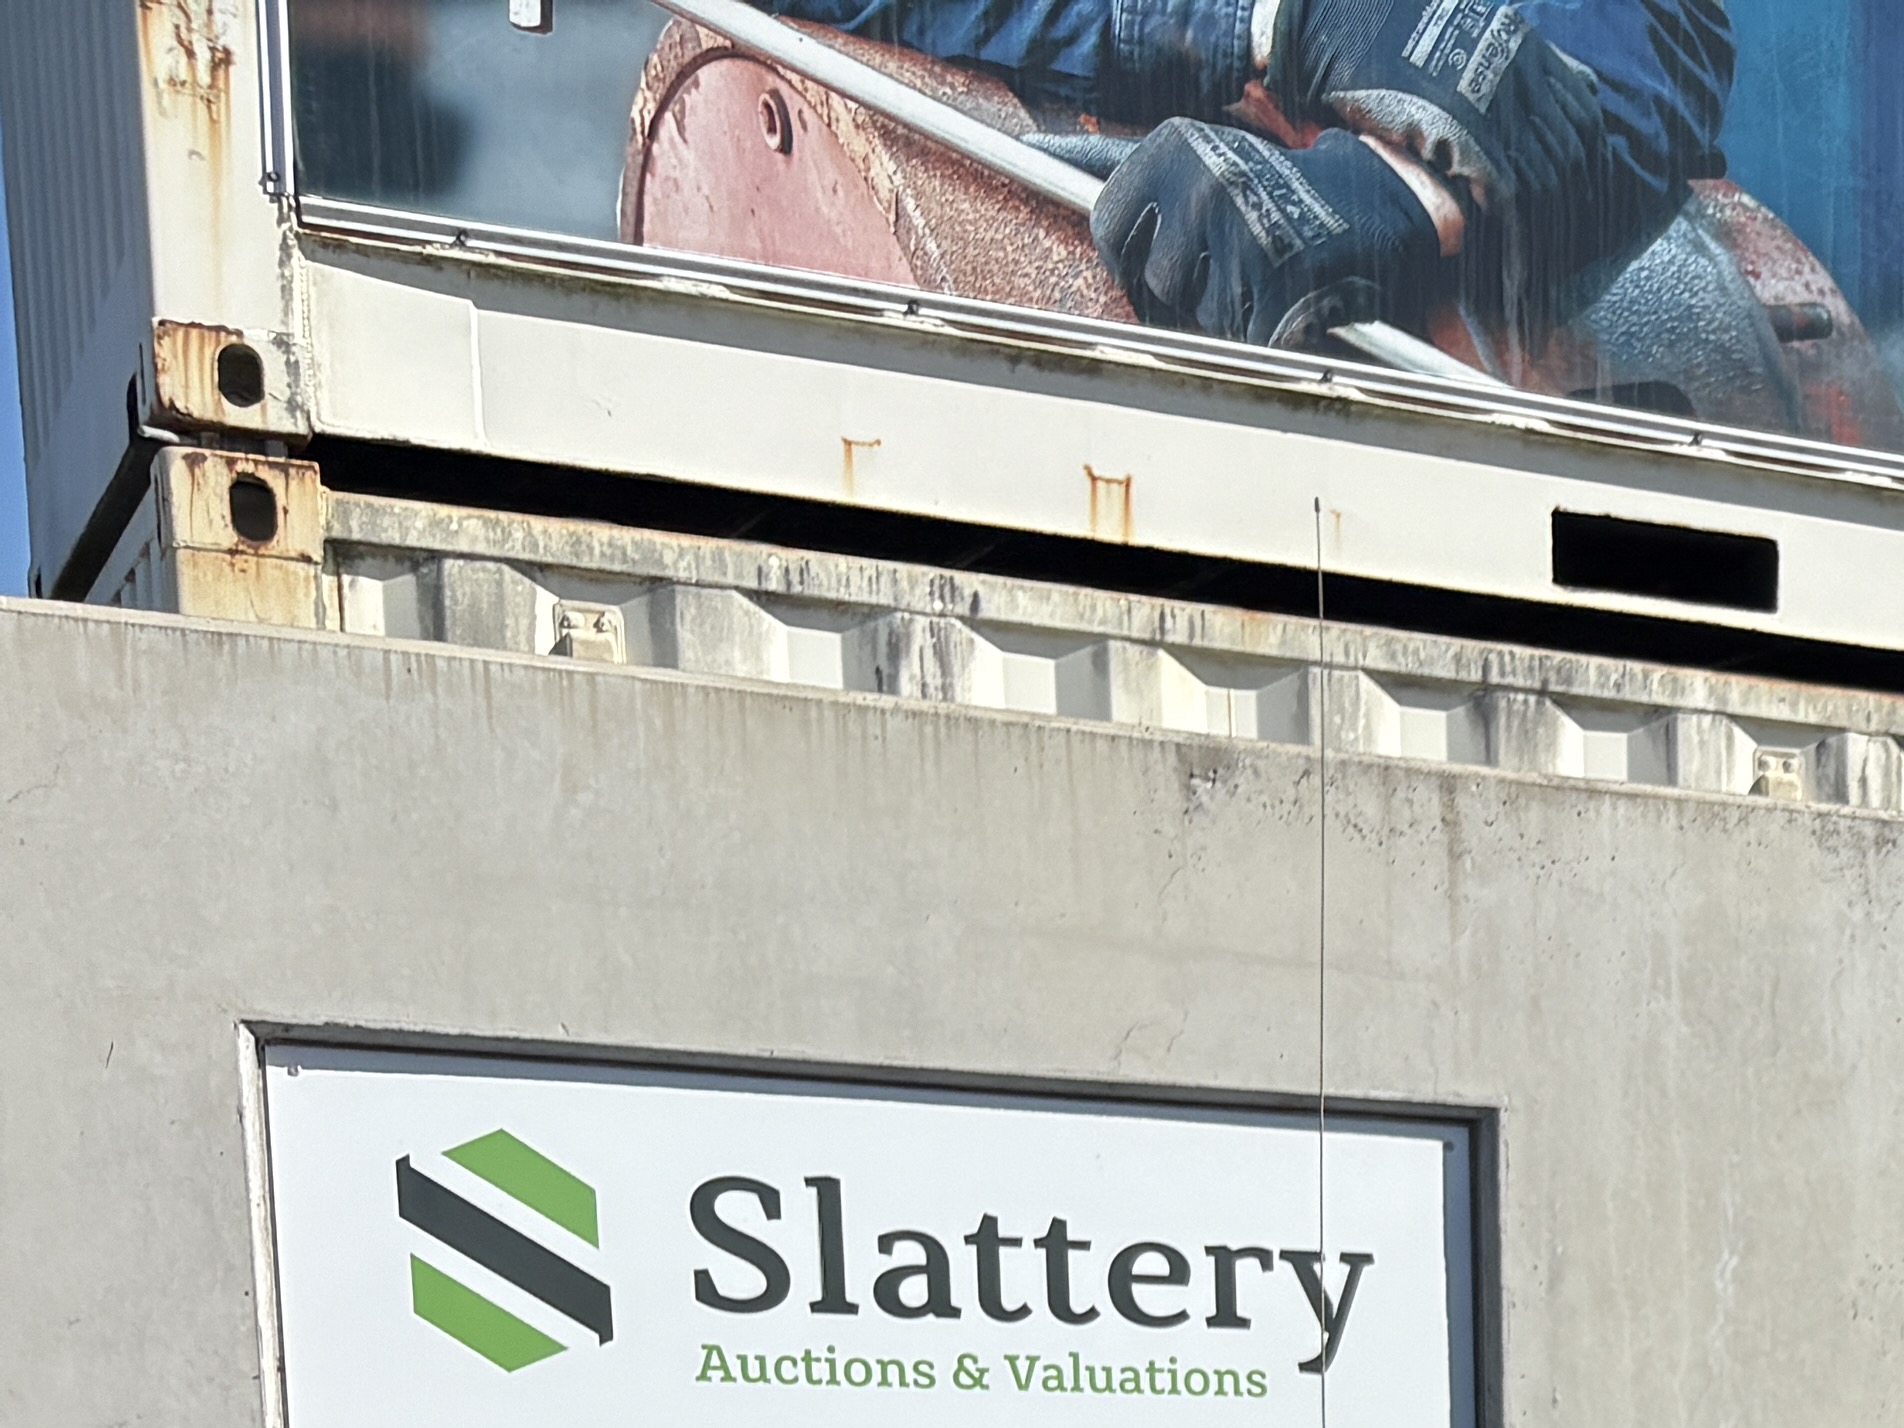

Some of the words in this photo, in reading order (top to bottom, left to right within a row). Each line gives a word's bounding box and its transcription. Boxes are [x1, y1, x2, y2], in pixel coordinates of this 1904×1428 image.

[688, 1172, 1375, 1374] Slattery
[696, 1345, 935, 1388] Auctions
[953, 1354, 989, 1389] &
[1004, 1353, 1266, 1396] Valuations
